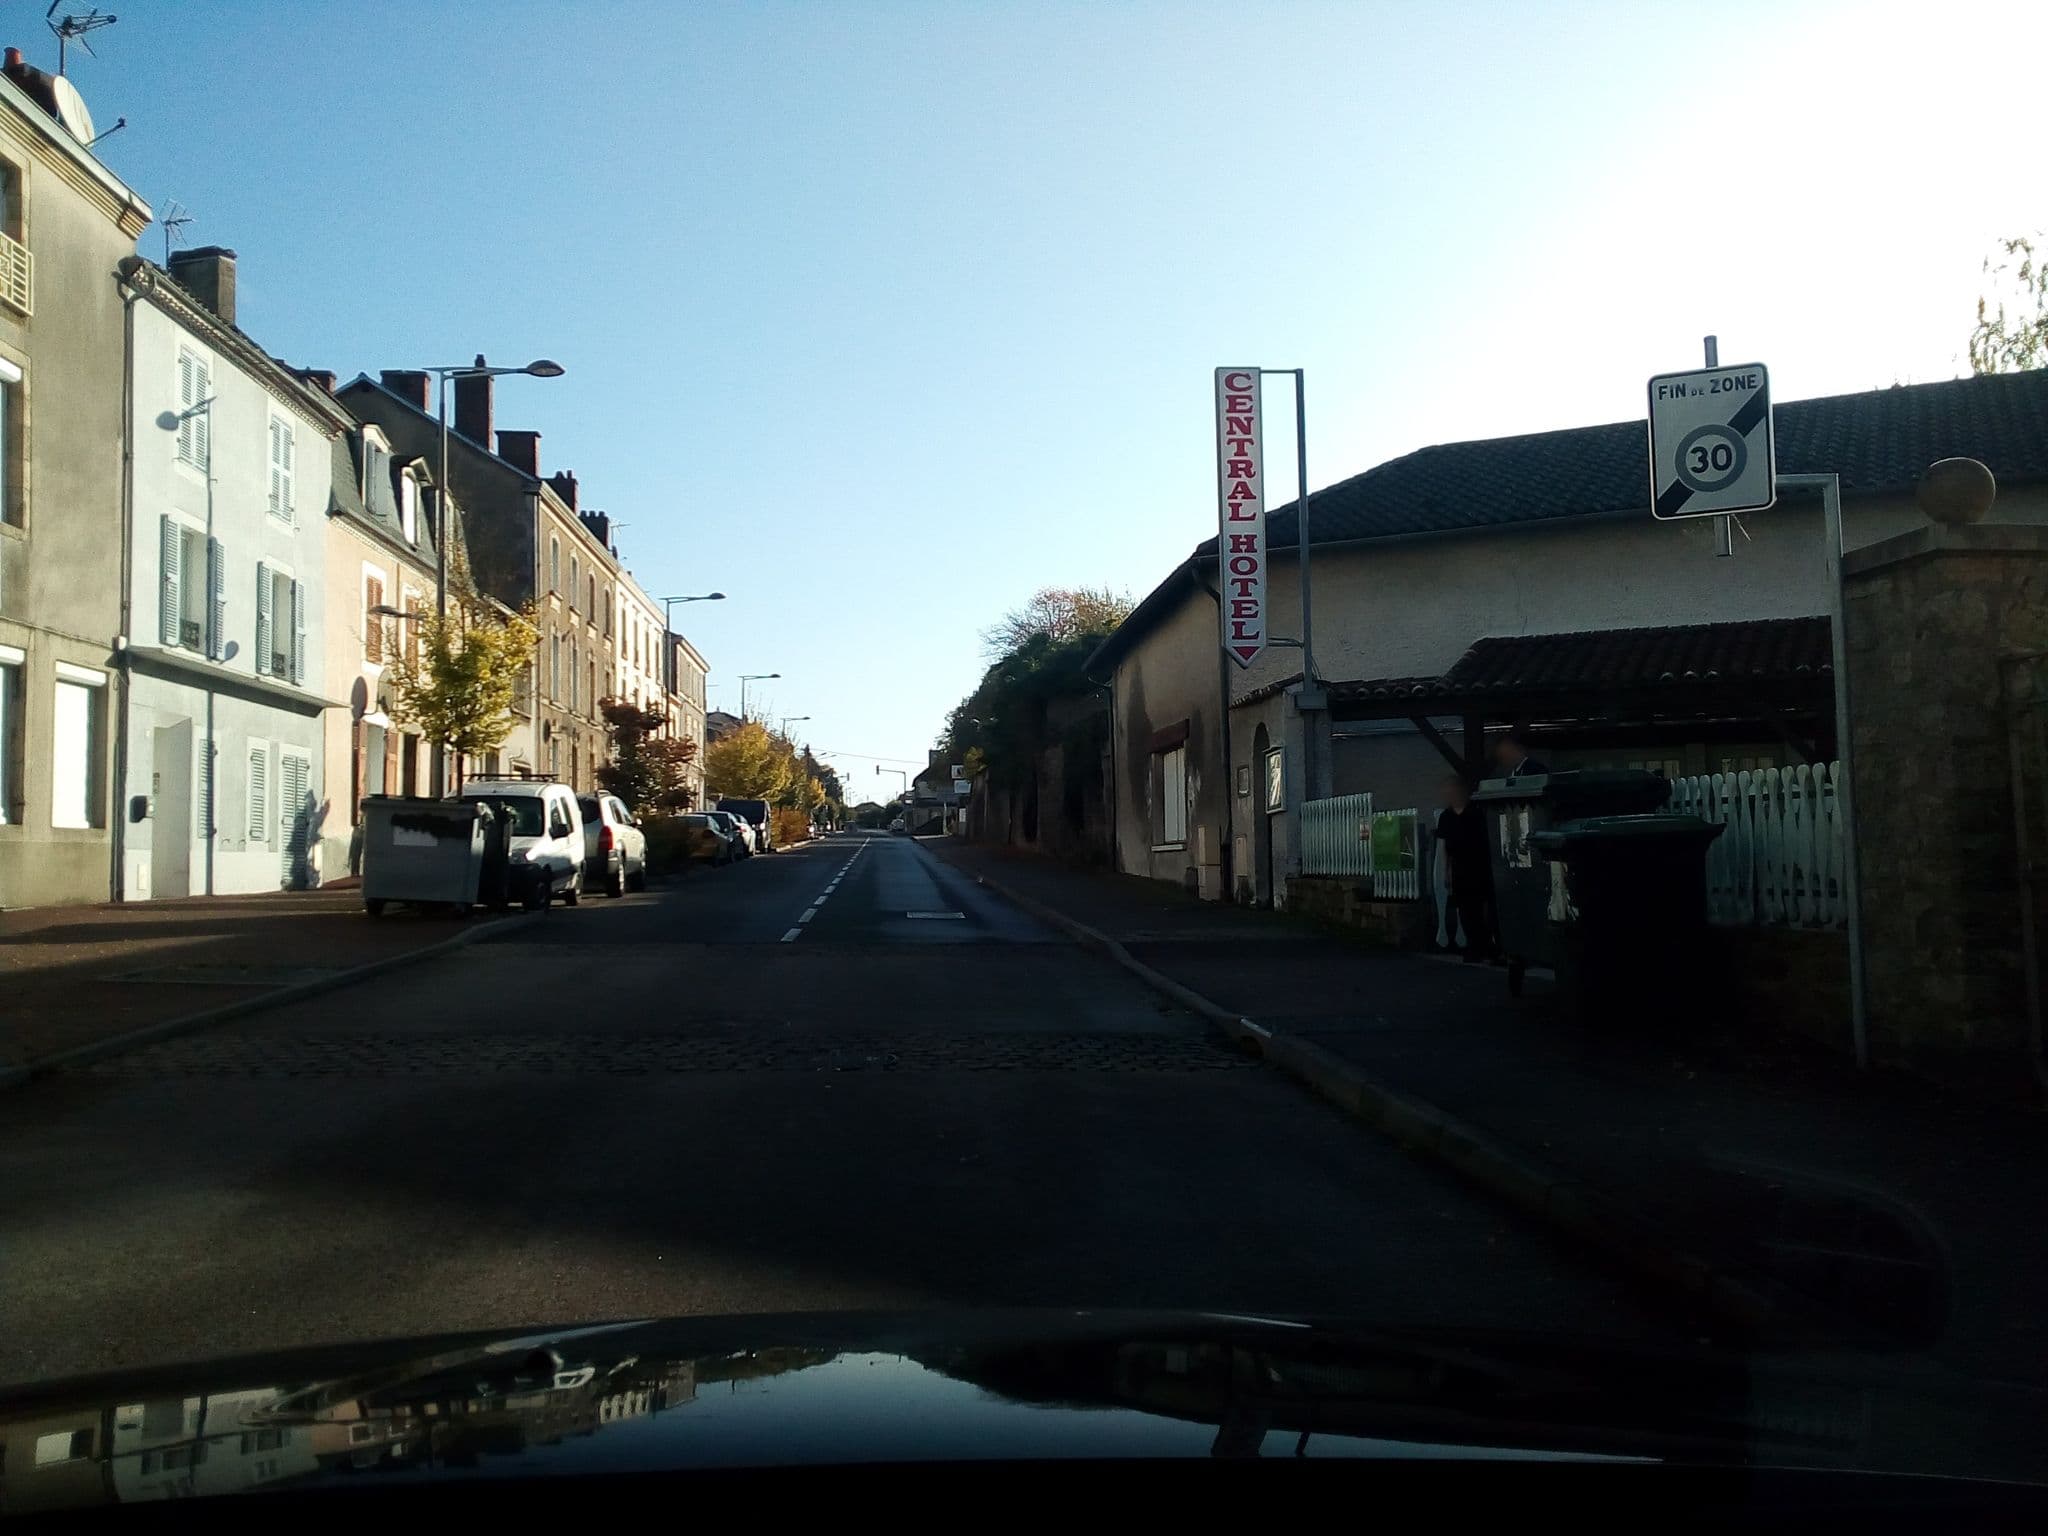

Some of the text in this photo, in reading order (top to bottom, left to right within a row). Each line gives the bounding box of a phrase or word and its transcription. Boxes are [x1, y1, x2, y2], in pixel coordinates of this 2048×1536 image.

[1658, 383, 1687, 401] FIN
[1710, 374, 1758, 394] ZONE
[1689, 444, 1733, 474] 30
[1225, 372, 1260, 641] CENTRAL HOTEL
